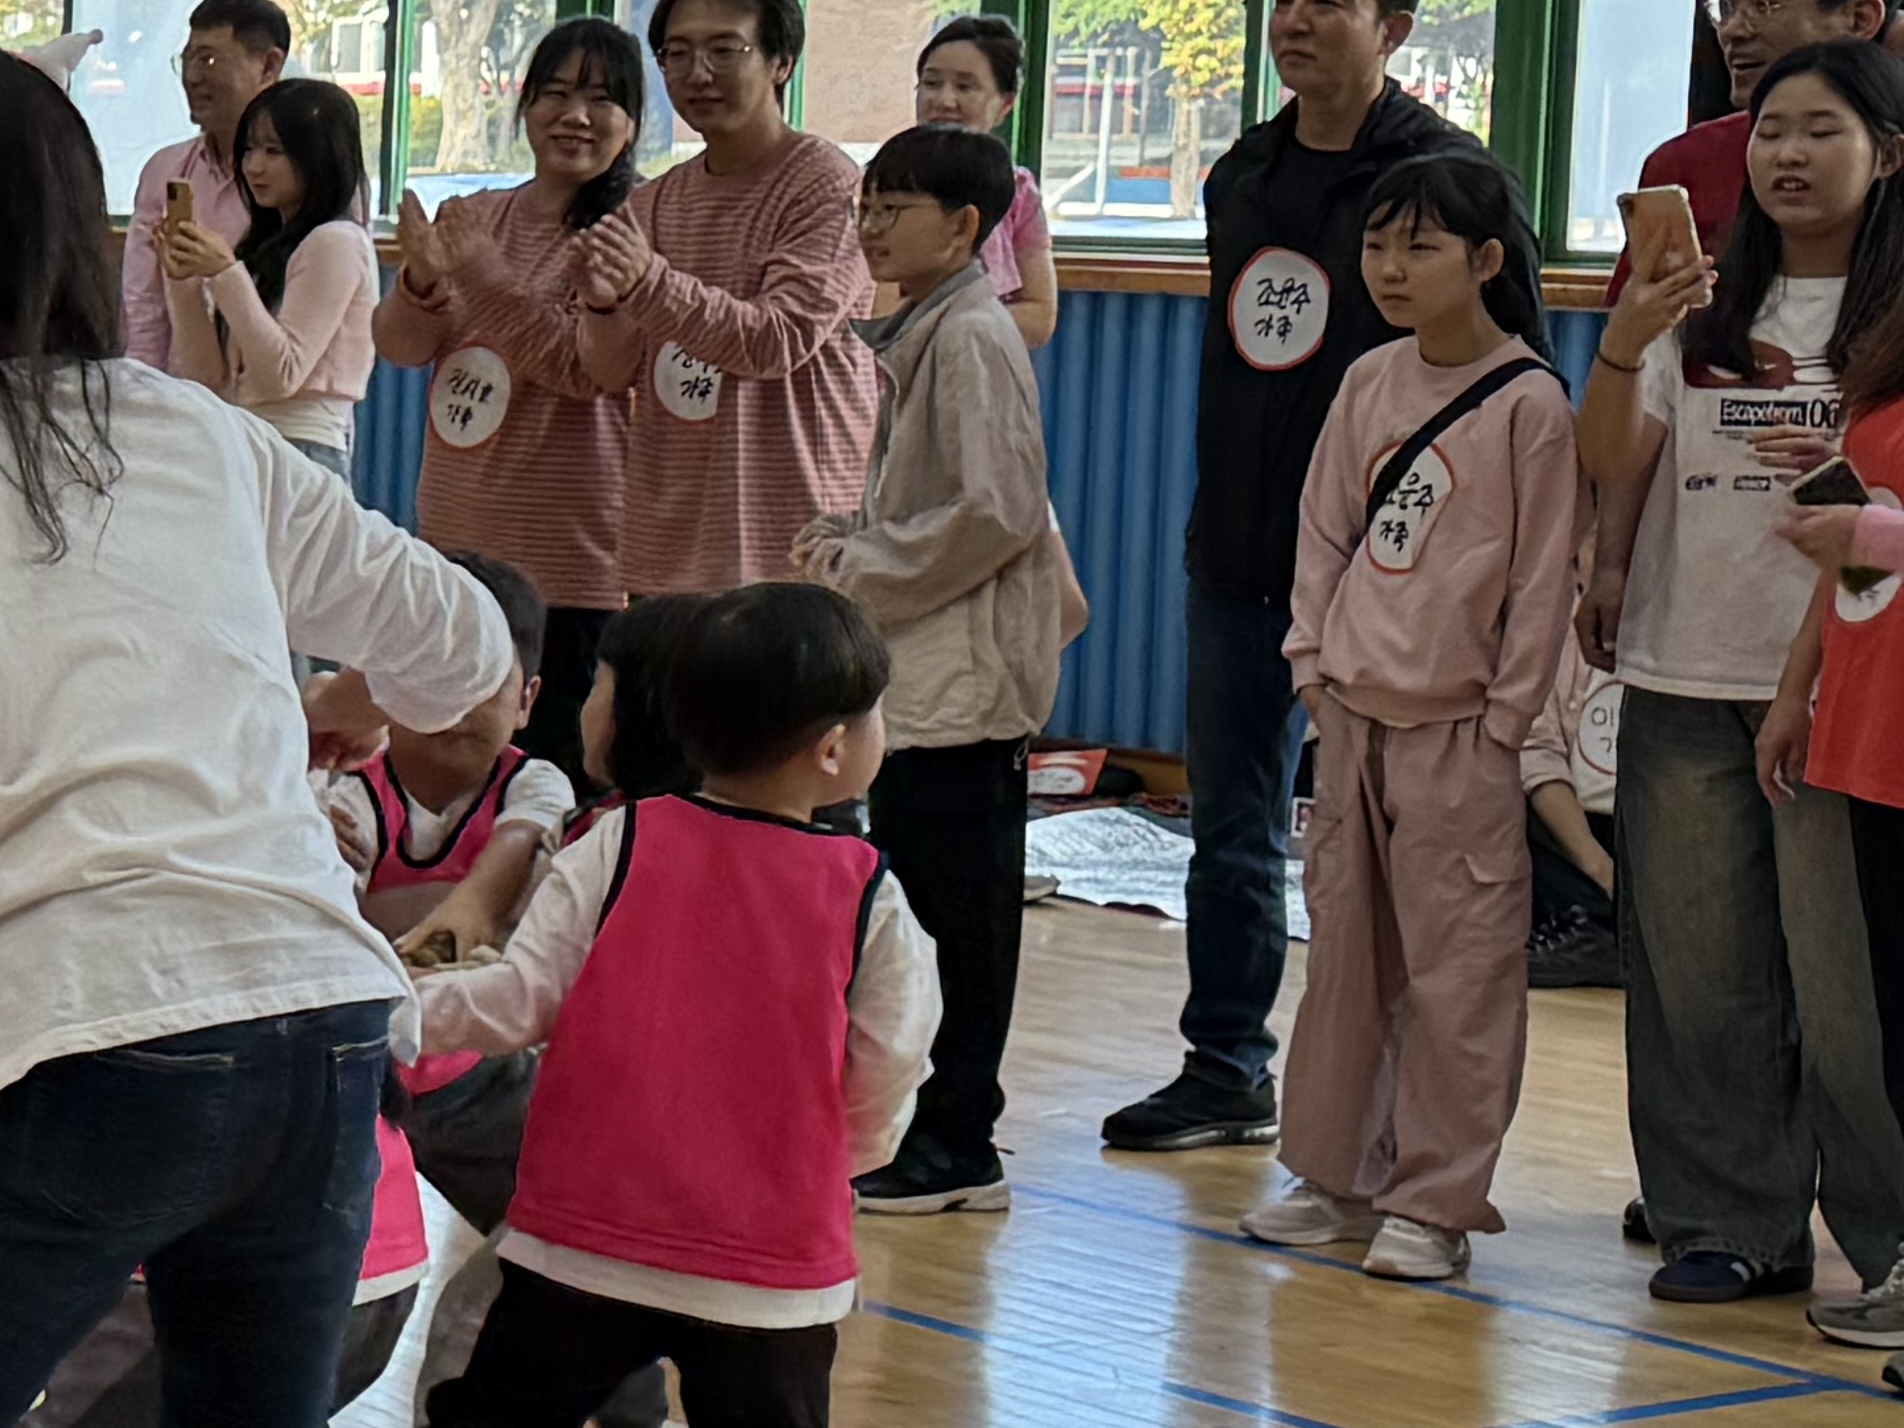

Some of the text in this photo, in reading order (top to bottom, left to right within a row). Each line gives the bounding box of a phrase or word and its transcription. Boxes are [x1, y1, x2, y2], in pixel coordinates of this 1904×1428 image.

[1253, 313, 1293, 345] 가족
[679, 375, 715, 404] 가족
[1378, 519, 1410, 553] 가족
